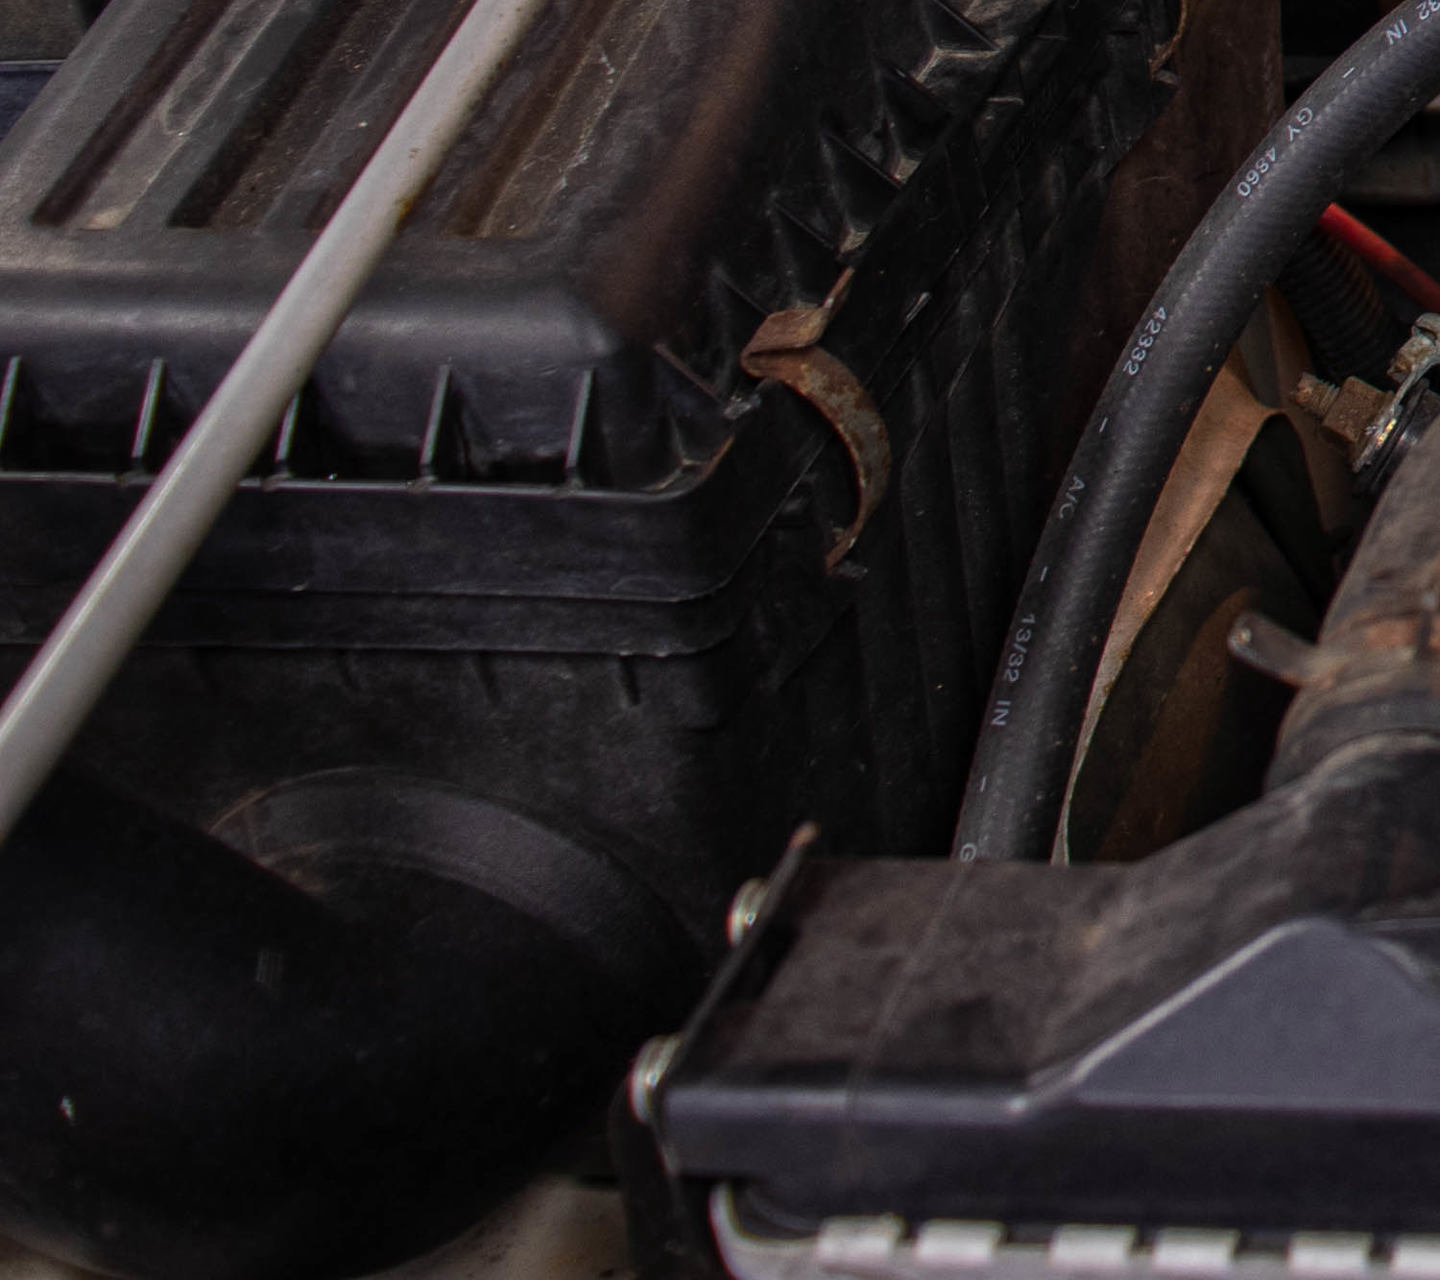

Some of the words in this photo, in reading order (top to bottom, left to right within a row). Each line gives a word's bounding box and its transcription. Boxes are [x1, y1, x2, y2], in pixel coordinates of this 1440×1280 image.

[1385, 16, 1410, 47] IN
[1286, 106, 1315, 142] GY
[1236, 145, 1277, 197] 4860
[1122, 305, 1167, 377] 42332
[1058, 474, 1086, 520] A/C
[1003, 612, 1036, 683] 13/32
[990, 699, 1012, 727] IN
